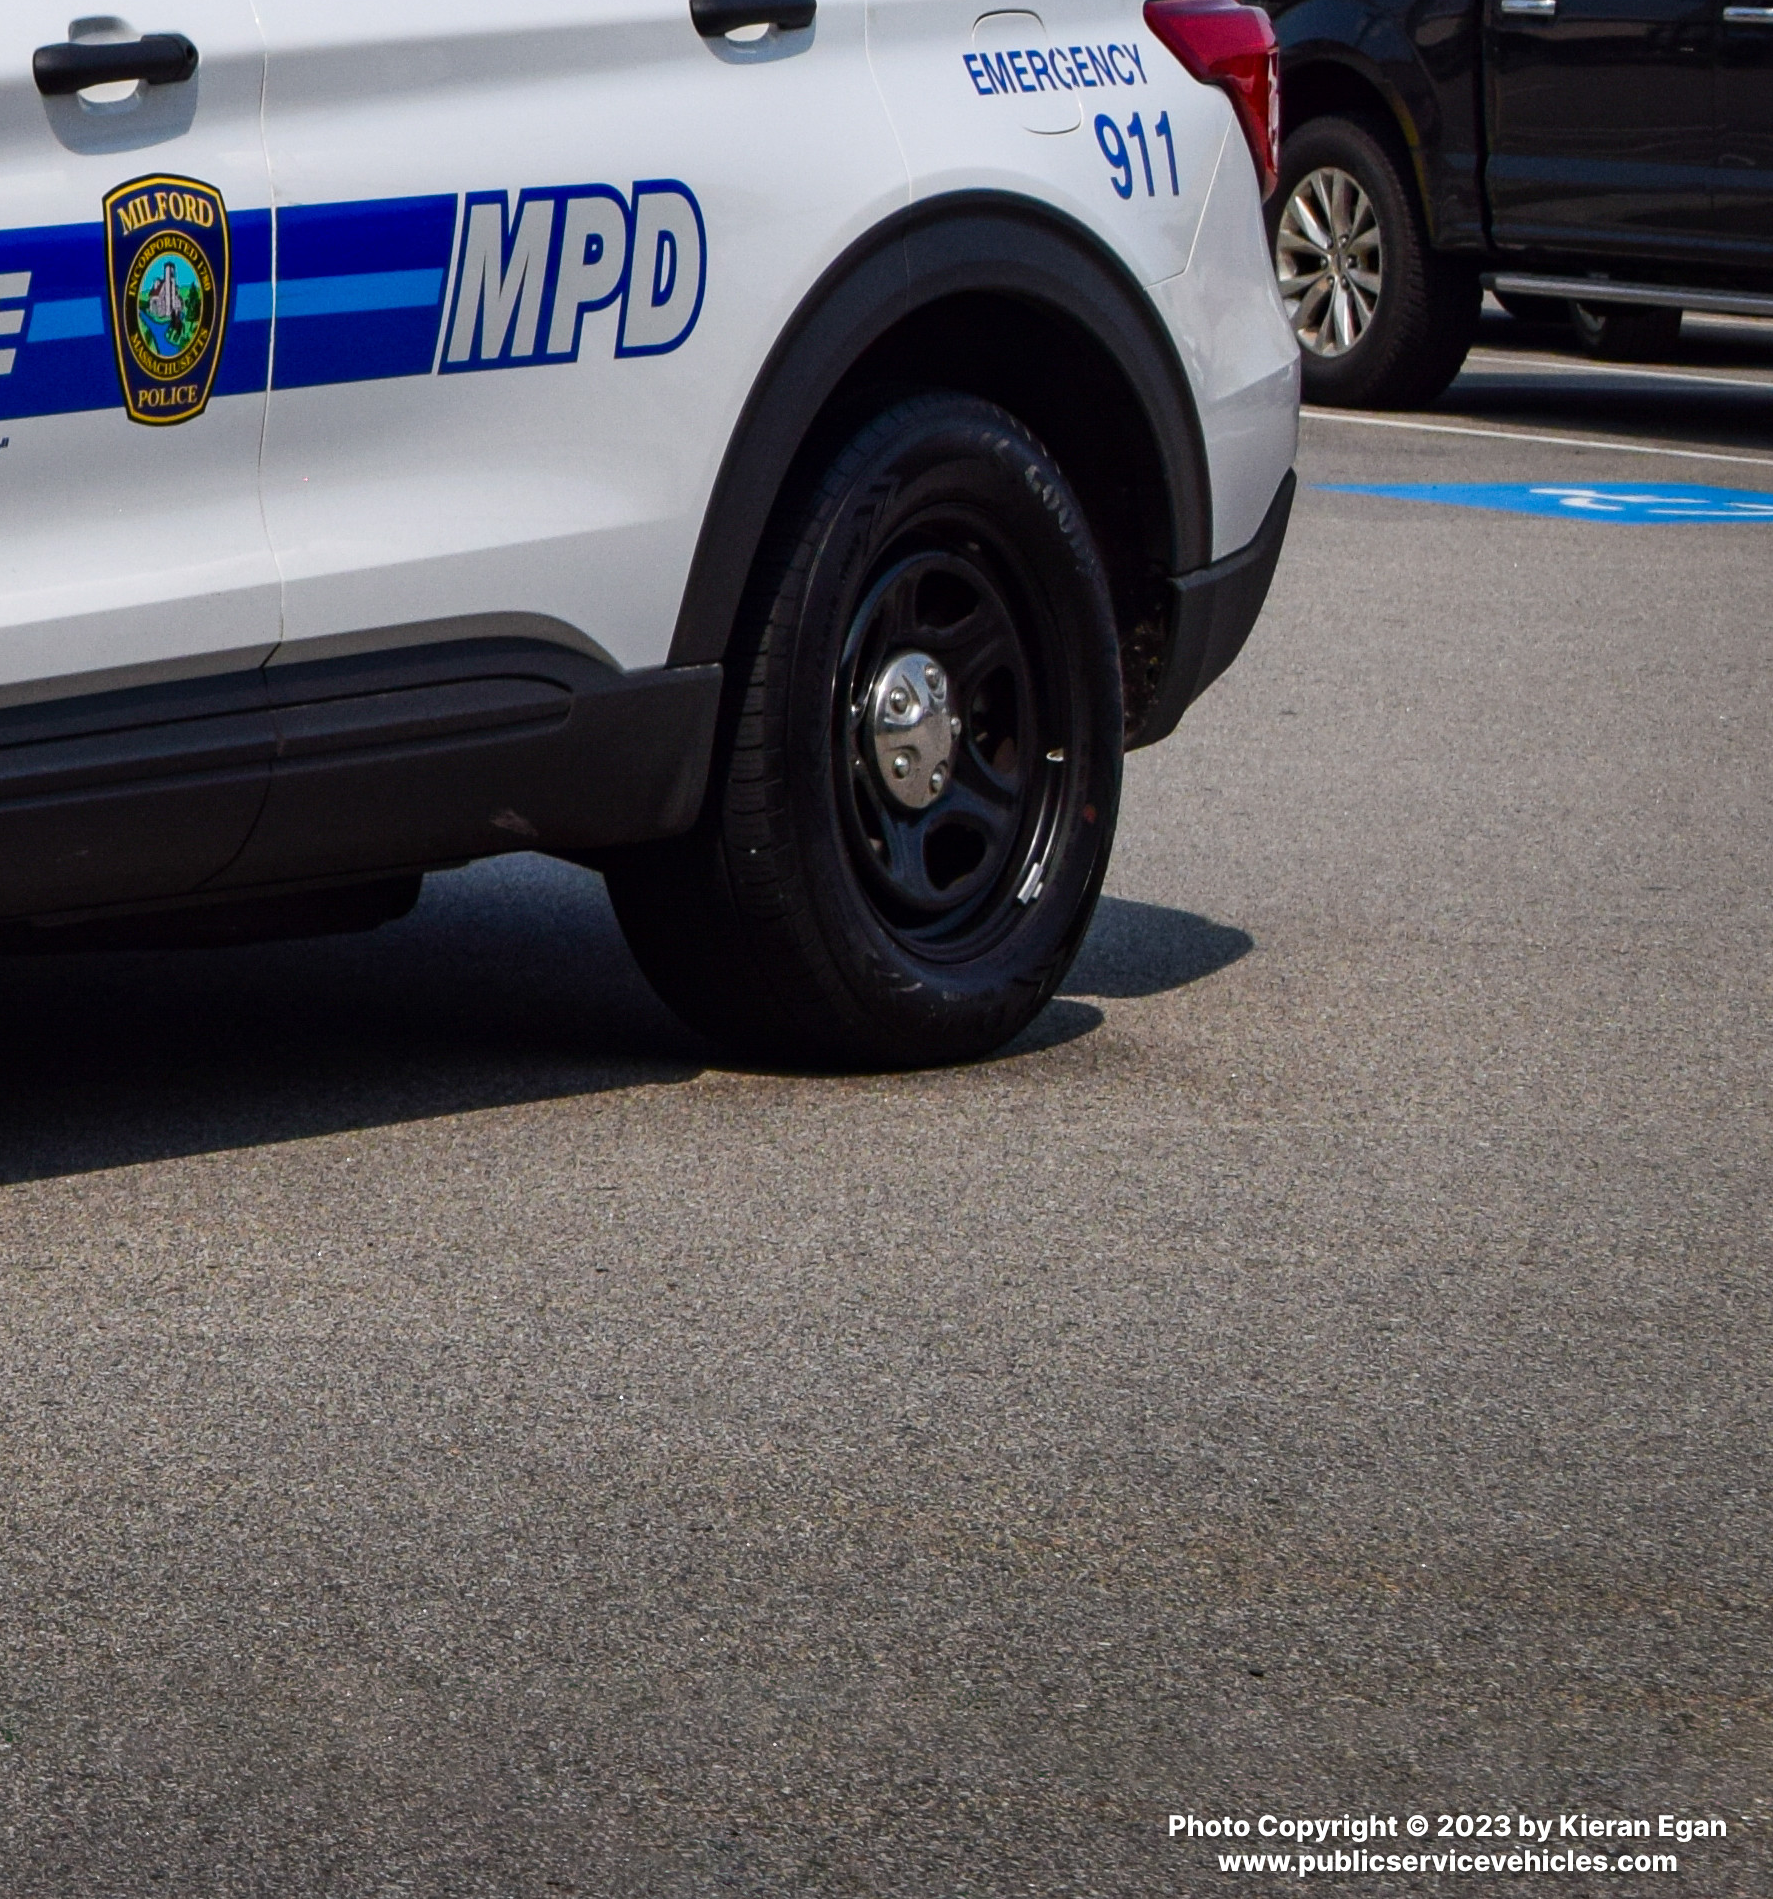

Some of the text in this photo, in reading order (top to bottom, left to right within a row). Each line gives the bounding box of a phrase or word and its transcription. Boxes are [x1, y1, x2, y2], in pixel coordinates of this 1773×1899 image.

[963, 43, 1147, 95] EMERGENCY
[1094, 110, 1179, 200] 911
[116, 191, 215, 236] MILFORD
[128, 236, 198, 296] INCORPORATED
[437, 178, 707, 375] MPD
[130, 328, 209, 376] MASSACHUSETTS
[137, 385, 198, 408] POLICE
